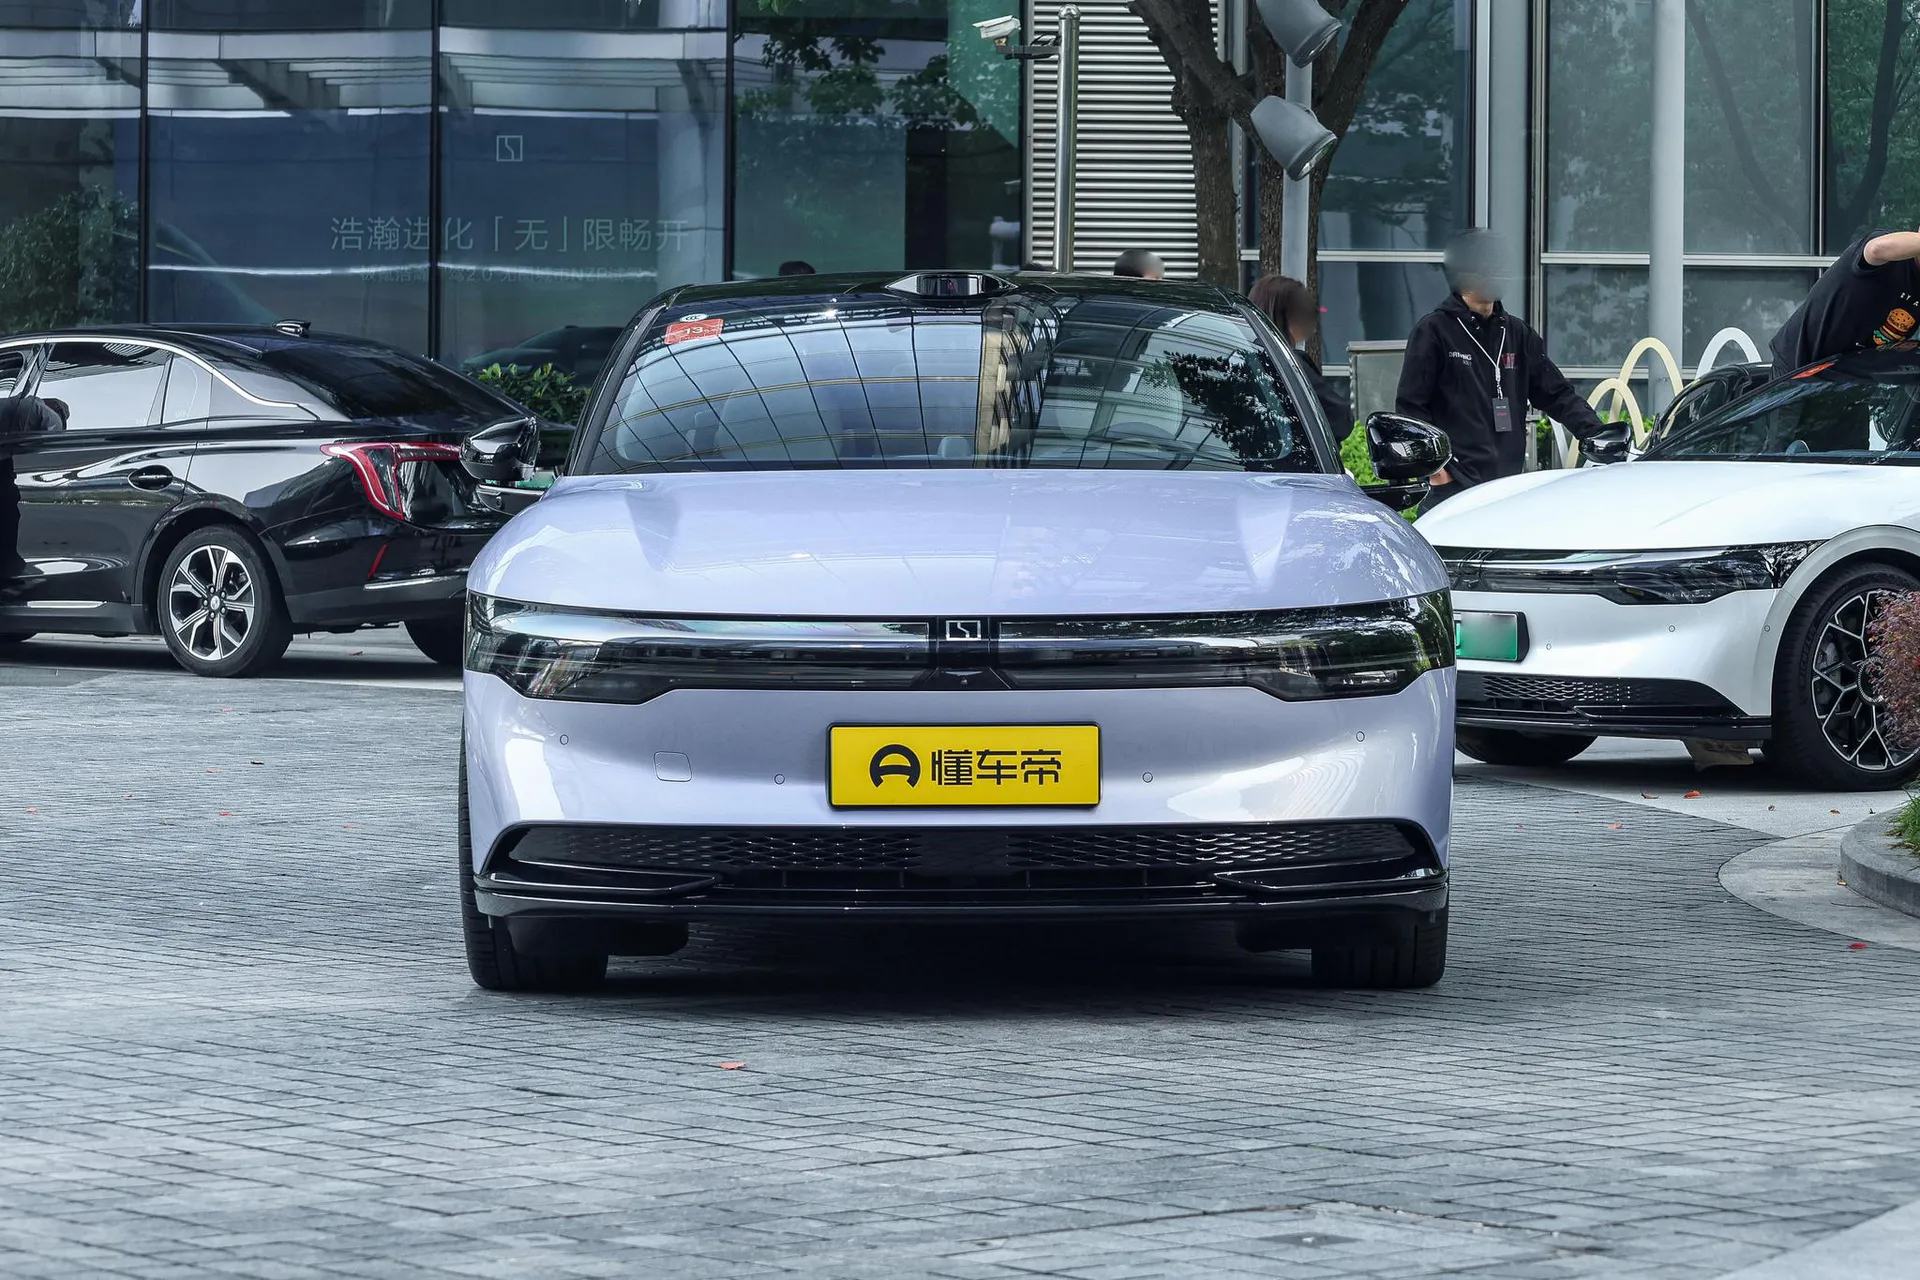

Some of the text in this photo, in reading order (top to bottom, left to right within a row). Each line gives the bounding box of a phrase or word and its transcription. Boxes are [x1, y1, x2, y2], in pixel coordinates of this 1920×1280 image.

[330, 215, 689, 253] 浩瀚进化「无」限畅开
[931, 748, 1062, 787] 懂车帝
